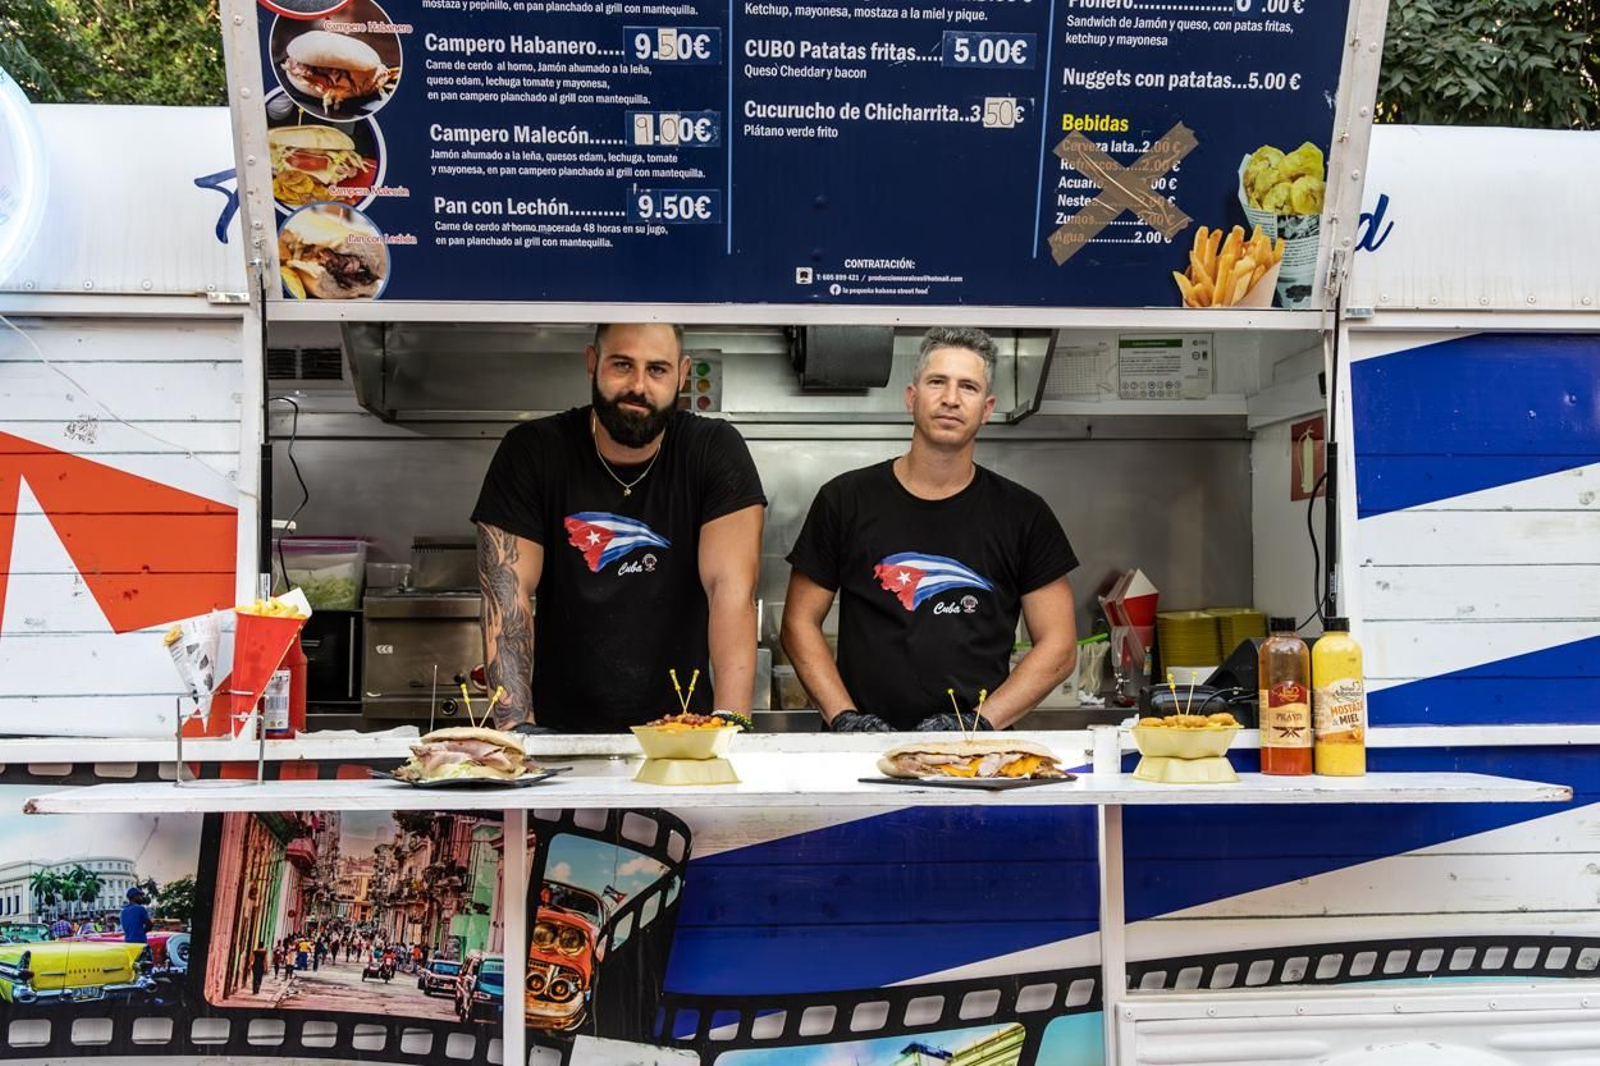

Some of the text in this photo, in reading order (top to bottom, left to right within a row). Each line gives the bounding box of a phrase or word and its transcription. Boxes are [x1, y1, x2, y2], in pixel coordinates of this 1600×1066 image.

[422, 0, 699, 16] mostaza y pepinillo, en pan planchado al grill con mantequilla.
[745, 3, 988, 23] Ketchup, mayonesa, mostaza a la miel y pique.
[1066, 15, 1294, 34] Sandwich de Jamón y queso, con patas fritas,
[425, 33, 506, 56] Campero
[634, 33, 711, 60] 9.50€
[1065, 32, 1168, 48] ketchup y mayonesa
[745, 40, 796, 58] CUBO
[800, 41, 866, 60] Patatas
[954, 38, 1028, 64] 5.00€
[454, 60, 466, 70] de
[467, 60, 493, 71] cerdo
[497, 61, 506, 71] al
[538, 62, 567, 73] Jamón
[568, 63, 610, 74] ahumado
[612, 66, 619, 74] a
[620, 64, 628, 74] la
[630, 64, 652, 76] leña,
[744, 64, 867, 80] Queso Cheddar y bacon
[426, 76, 610, 90] queso edam, lechuga tomate y mayonesa,
[1063, 68, 1131, 90] Nuggets
[1135, 73, 1165, 87] con
[428, 92, 439, 100] en
[440, 92, 458, 101] pan
[460, 93, 499, 103] campero
[500, 92, 548, 103] planchado
[549, 93, 557, 102] al
[560, 94, 577, 104] grill
[596, 94, 651, 105] mantequilla.
[744, 100, 835, 119] Cucurucho
[840, 102, 860, 120] de
[744, 124, 838, 138] Plátano verde frito
[1062, 114, 1129, 132] Bebidas
[430, 124, 509, 146] Campero
[430, 149, 678, 164] Jamón ahumado a la leña, quesos edam, lechuga, tomate
[431, 165, 706, 179] y mayonesa, en pan campero planchado al grill con mantequilla.
[1169, 178, 1177, 190] €
[434, 197, 467, 214] Pan
[472, 201, 503, 215] con
[638, 195, 712, 219] 9.50€
[462, 222, 474, 231] de
[475, 222, 500, 232] cerdo
[538, 224, 581, 233] macerada
[583, 224, 595, 232] 48
[597, 225, 621, 233] horas
[622, 226, 633, 234] en
[635, 226, 645, 234] su
[646, 225, 668, 235] jugo,
[436, 237, 613, 249] en pan planchado al grill con mantequilla.
[845, 257, 915, 269] CONTRATACIÓN:
[618, 561, 643, 576] Cuba
[933, 602, 961, 615] Cuba
